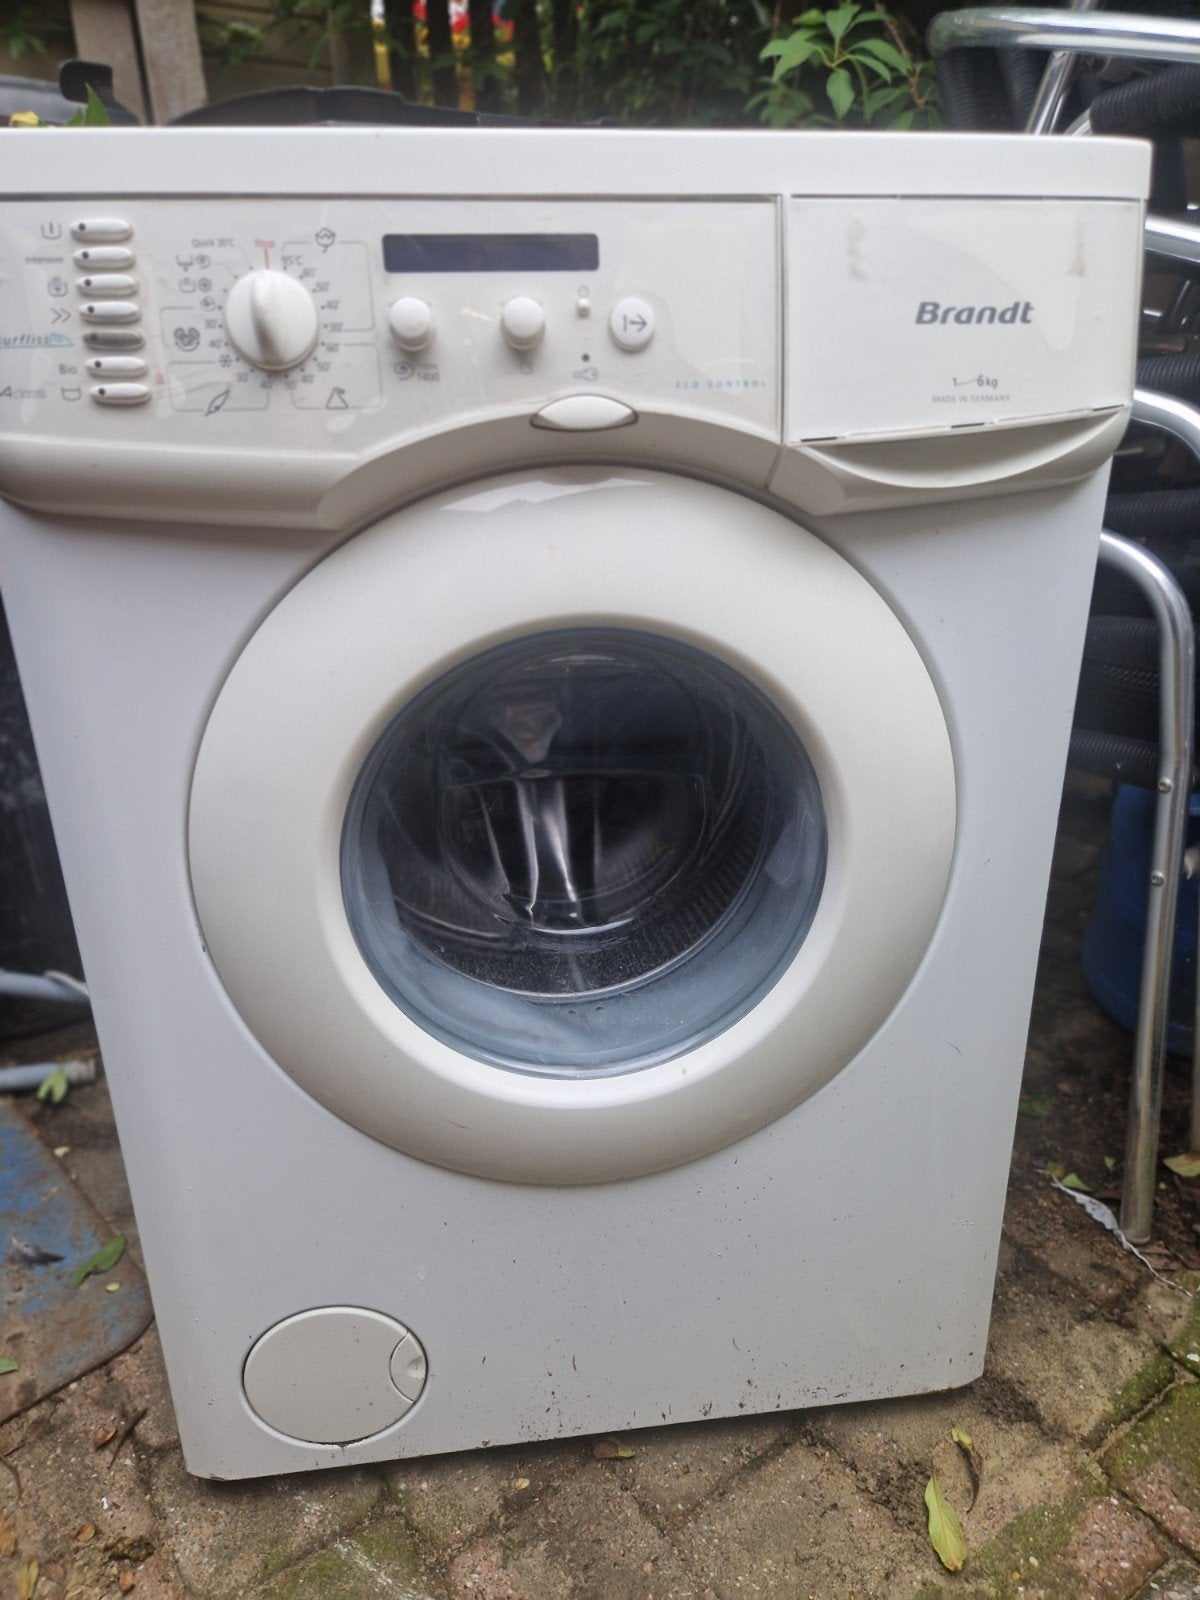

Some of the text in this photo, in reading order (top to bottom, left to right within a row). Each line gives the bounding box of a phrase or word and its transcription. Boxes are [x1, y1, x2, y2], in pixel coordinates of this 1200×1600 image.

[915, 301, 1035, 325] Brandt
[58, 363, 78, 375] Bio
[932, 394, 1011, 403] MADE IN GERMANY
